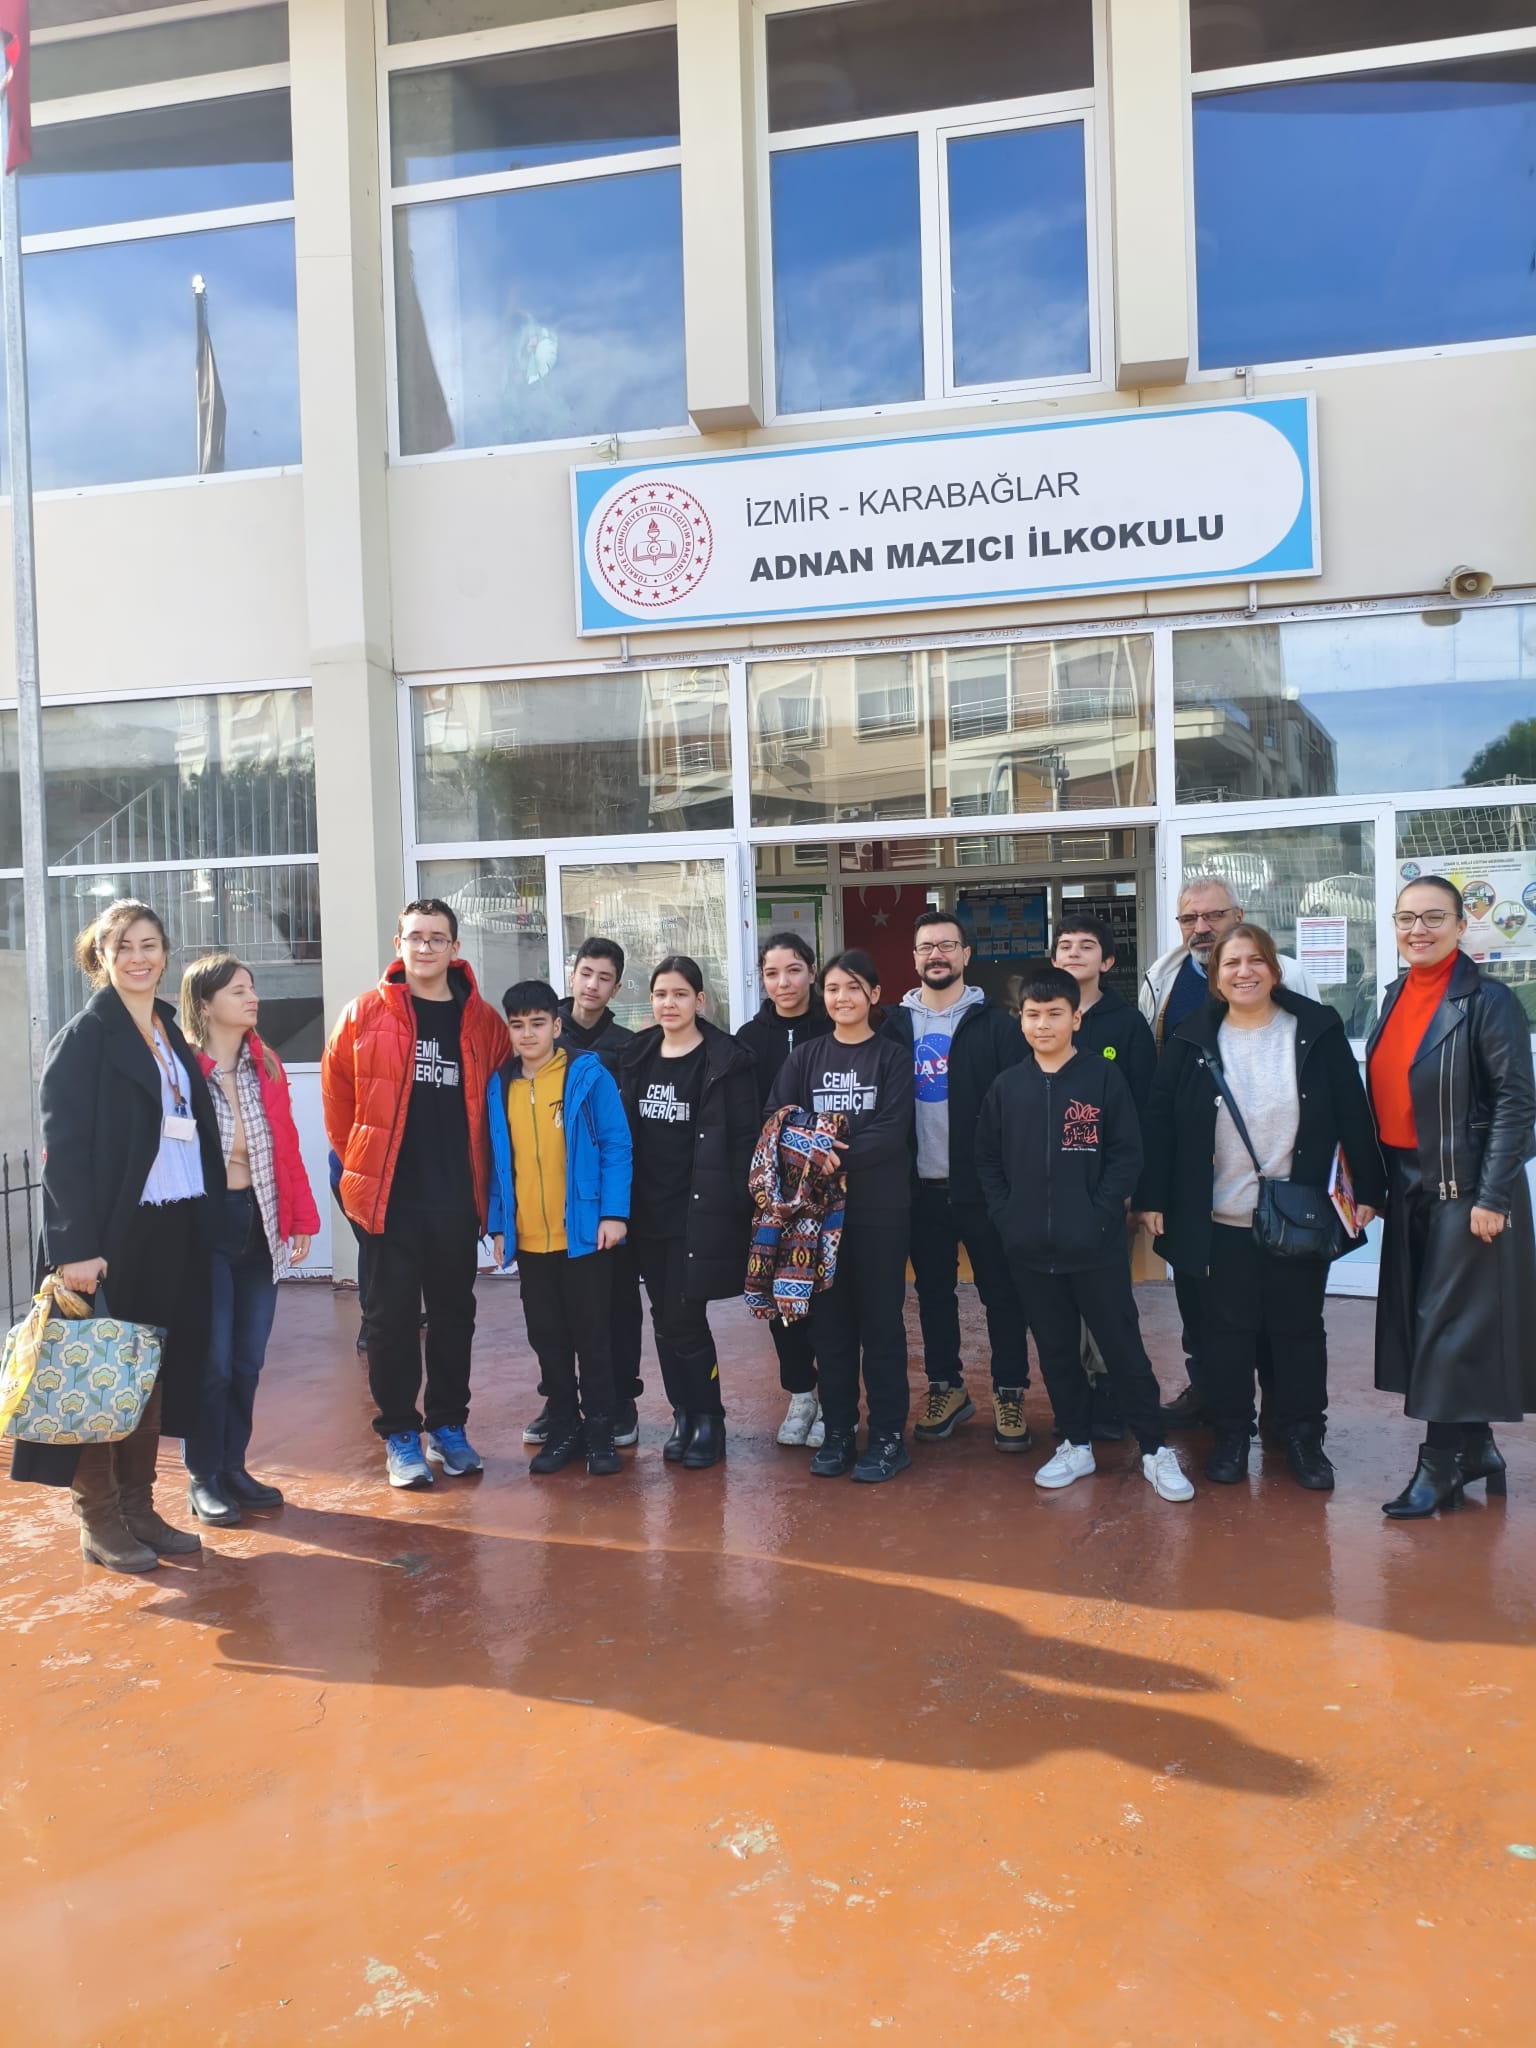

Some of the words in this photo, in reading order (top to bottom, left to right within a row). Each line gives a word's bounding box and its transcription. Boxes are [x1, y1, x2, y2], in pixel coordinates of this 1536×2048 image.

[746, 493, 830, 527] İZMİR
[859, 471, 1080, 516] KARABAĞLAR
[617, 505, 648, 556] CUMHURİYETİ
[672, 512, 691, 540] EĞİTİM
[664, 541, 692, 581] BAKANLIĞI
[750, 547, 873, 582] ADNAN
[887, 535, 1013, 569] MAZICI
[1029, 514, 1223, 557] İLKOKULU
[415, 1037, 442, 1059] EMİL
[823, 1069, 860, 1088] CEMİL
[915, 1059, 948, 1075] AS
[646, 1082, 678, 1101] CEMİL
